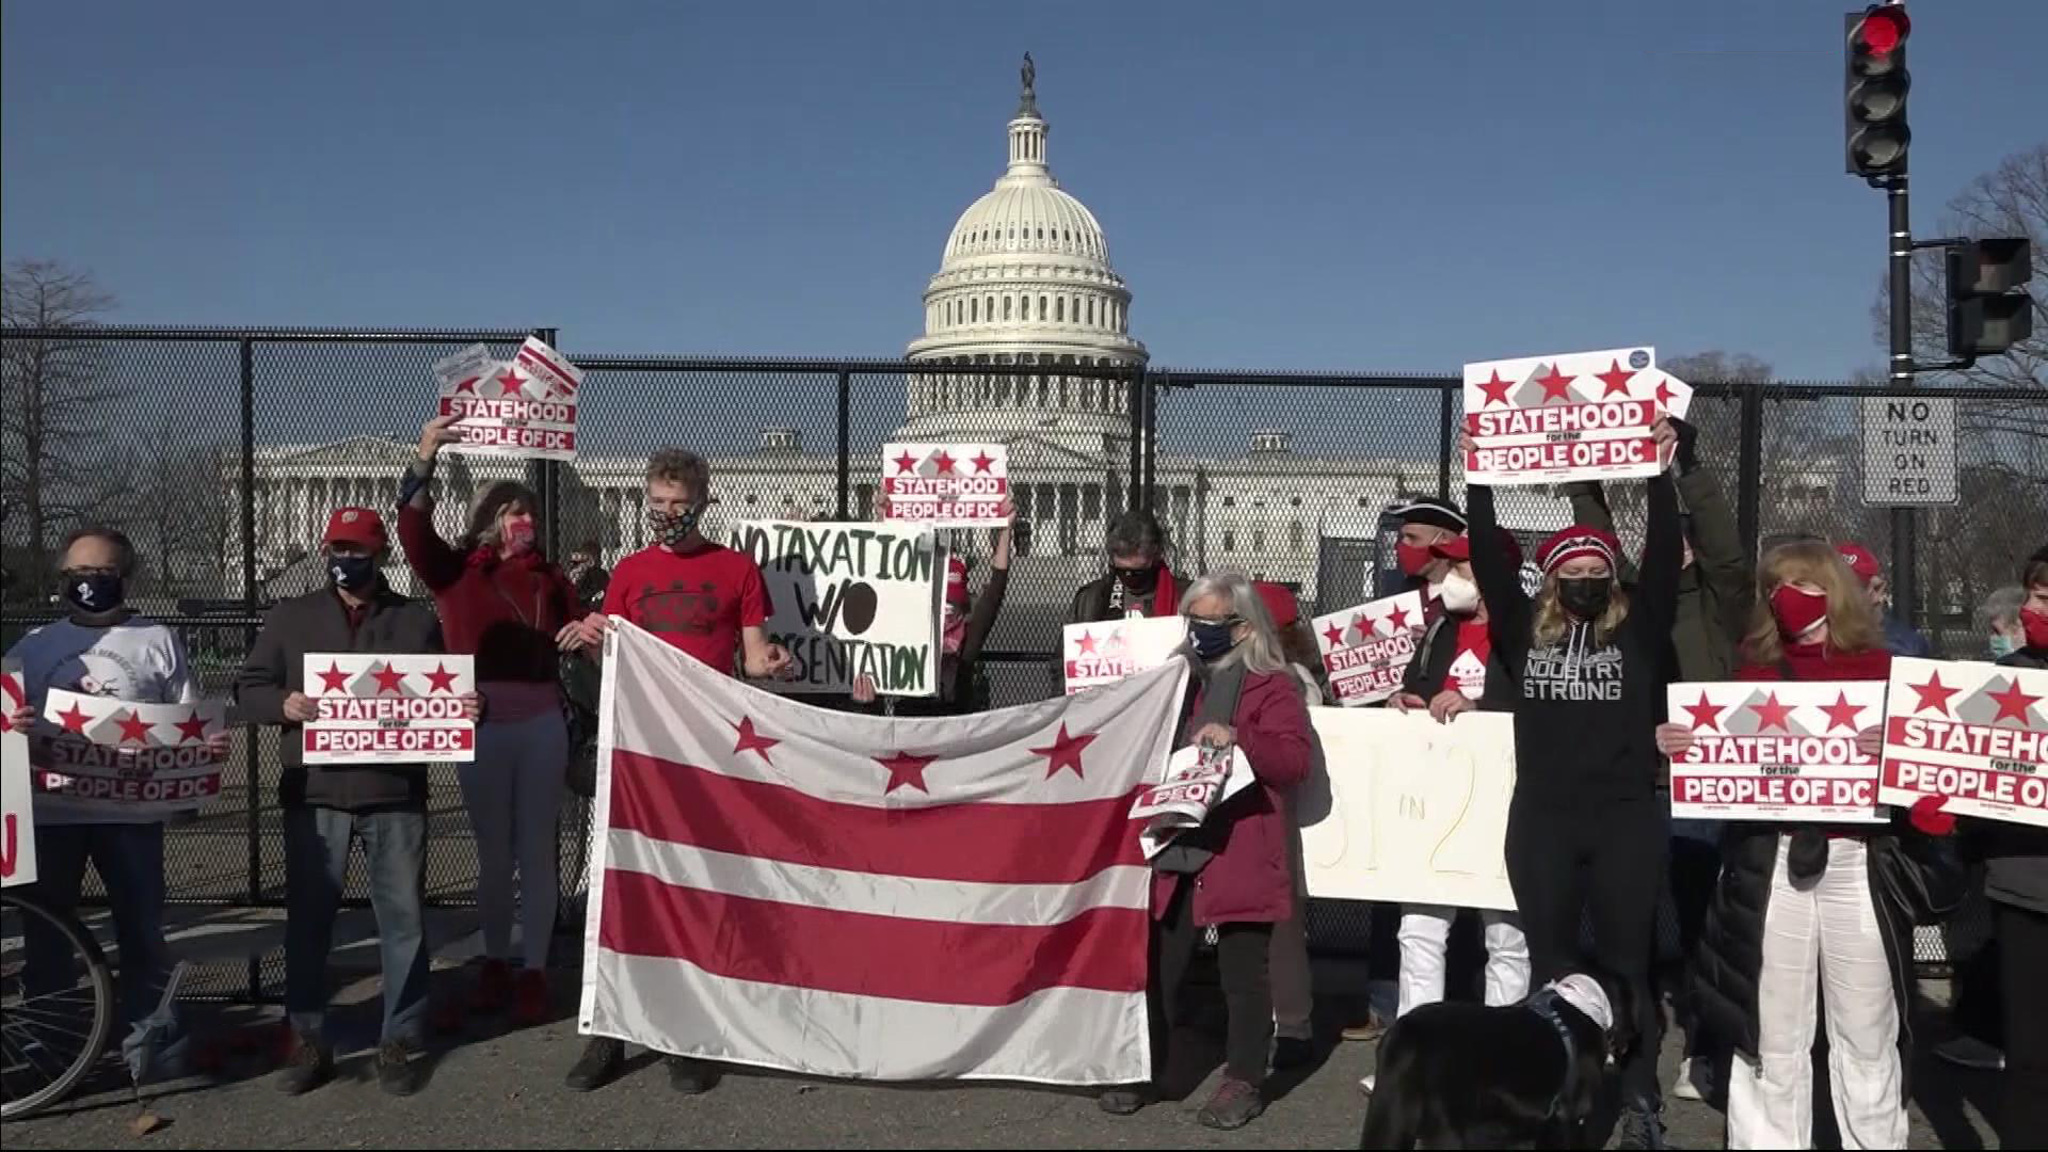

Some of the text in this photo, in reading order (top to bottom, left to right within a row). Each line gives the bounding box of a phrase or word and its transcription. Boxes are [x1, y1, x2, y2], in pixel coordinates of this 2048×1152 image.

[450, 399, 568, 421] STATEHOOD
[1478, 402, 1643, 436] STATEHOOD
[1888, 403, 1929, 421] NO
[521, 428, 544, 446] OF
[546, 432, 566, 448] DC
[1882, 430, 1937, 445] TURN
[1572, 442, 1606, 465] OF
[1609, 439, 1644, 464] DC
[1895, 454, 1925, 469] ON
[893, 478, 999, 494] STATEHOOD
[1890, 477, 1929, 493] RED
[892, 502, 999, 518] PEOPLE OF DC
[731, 524, 933, 582] NO TAXATION
[768, 632, 928, 690] SENTATION
[1075, 658, 1136, 678] STATE
[1337, 664, 1407, 696] PEOPLE O
[1523, 679, 1622, 700] STRONG
[318, 698, 463, 719] STATEHOOD
[315, 731, 462, 750] PEOPLE OF DC
[1903, 718, 2048, 764] STATEH
[51, 741, 212, 769] STATEHOOD
[1760, 765, 1800, 776] for the
[1990, 758, 2037, 774] for the
[46, 772, 139, 800] PEOPLE
[142, 781, 175, 800] OF
[179, 776, 209, 797] DC
[1684, 778, 1871, 807] PEOPLE OF DC
[1897, 762, 2048, 808] PEOPLE O
[1399, 793, 1425, 820] IN
